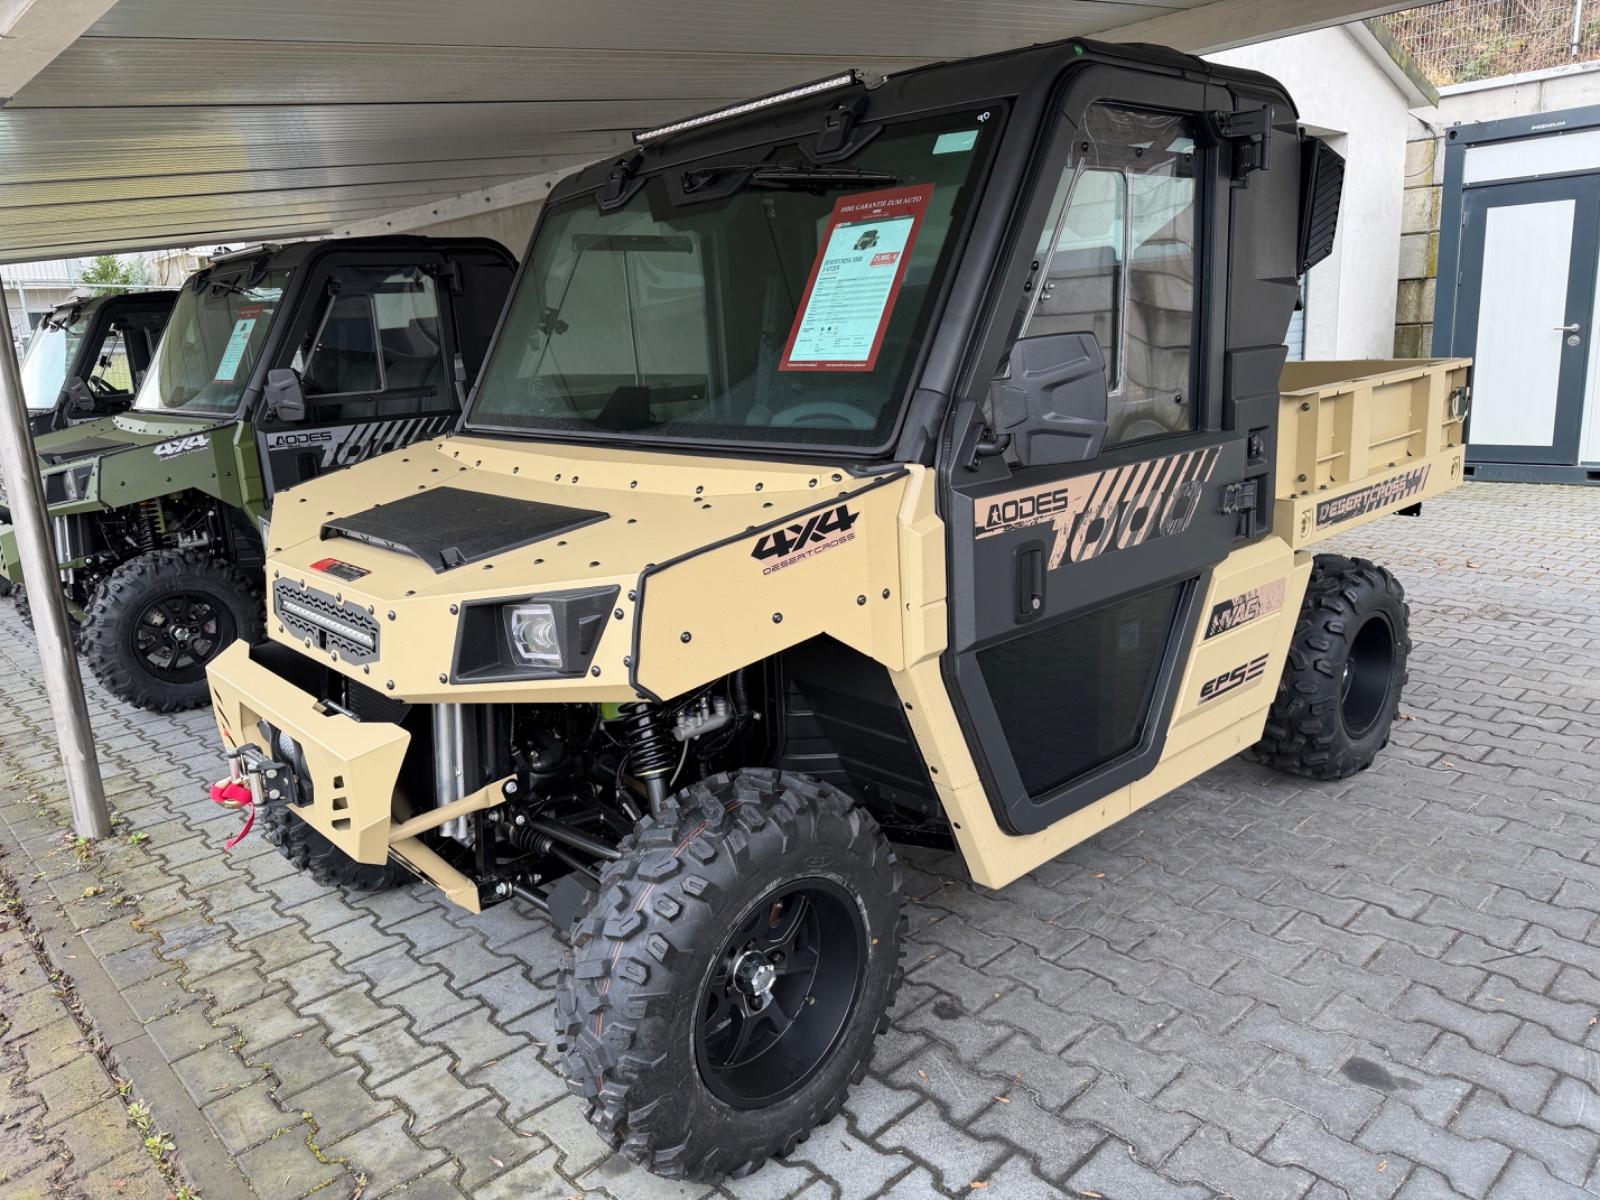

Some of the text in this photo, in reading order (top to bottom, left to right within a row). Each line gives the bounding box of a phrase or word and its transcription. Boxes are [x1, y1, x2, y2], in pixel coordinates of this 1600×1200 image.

[855, 200, 885, 211] GARANTIE
[903, 196, 922, 204] AUTO
[275, 431, 332, 446] AODES
[986, 488, 1069, 529] AODES
[1319, 476, 1407, 522] DESERTCROSS
[1047, 478, 1203, 571] 1000
[762, 532, 856, 576] DESERTCROSS
